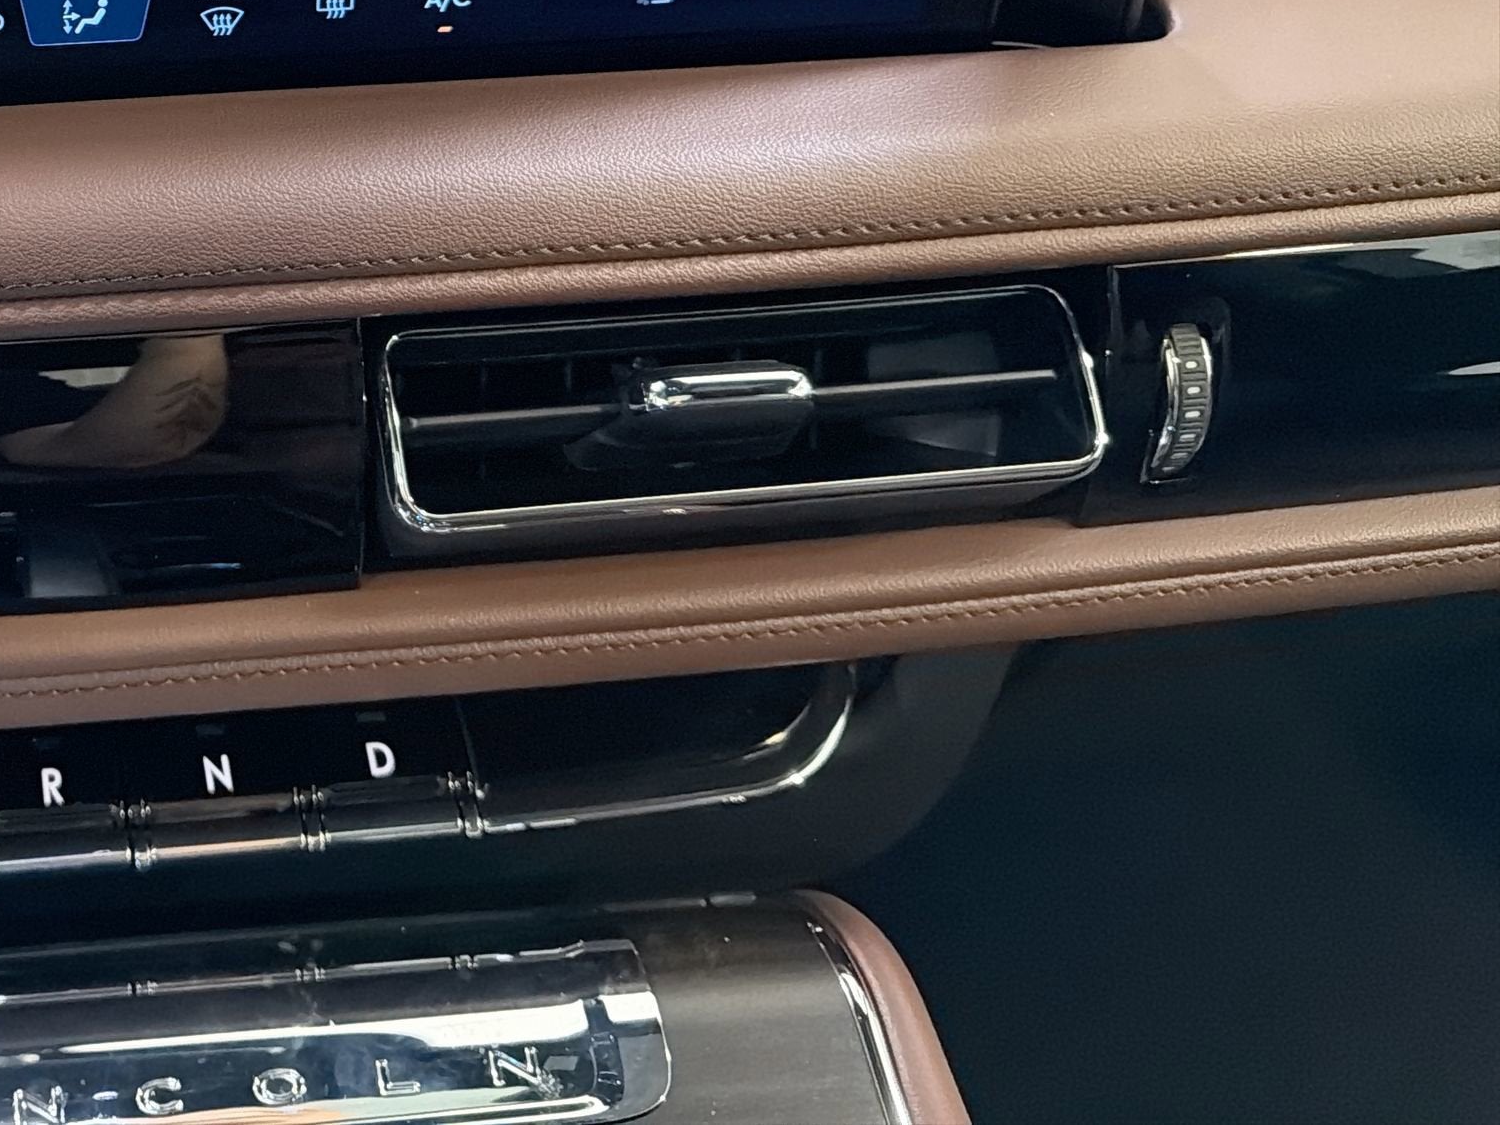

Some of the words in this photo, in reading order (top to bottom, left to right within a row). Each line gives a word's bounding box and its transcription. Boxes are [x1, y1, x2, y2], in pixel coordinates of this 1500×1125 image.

[202, 753, 234, 794] N
[365, 741, 396, 778] D
[41, 767, 65, 807] R
